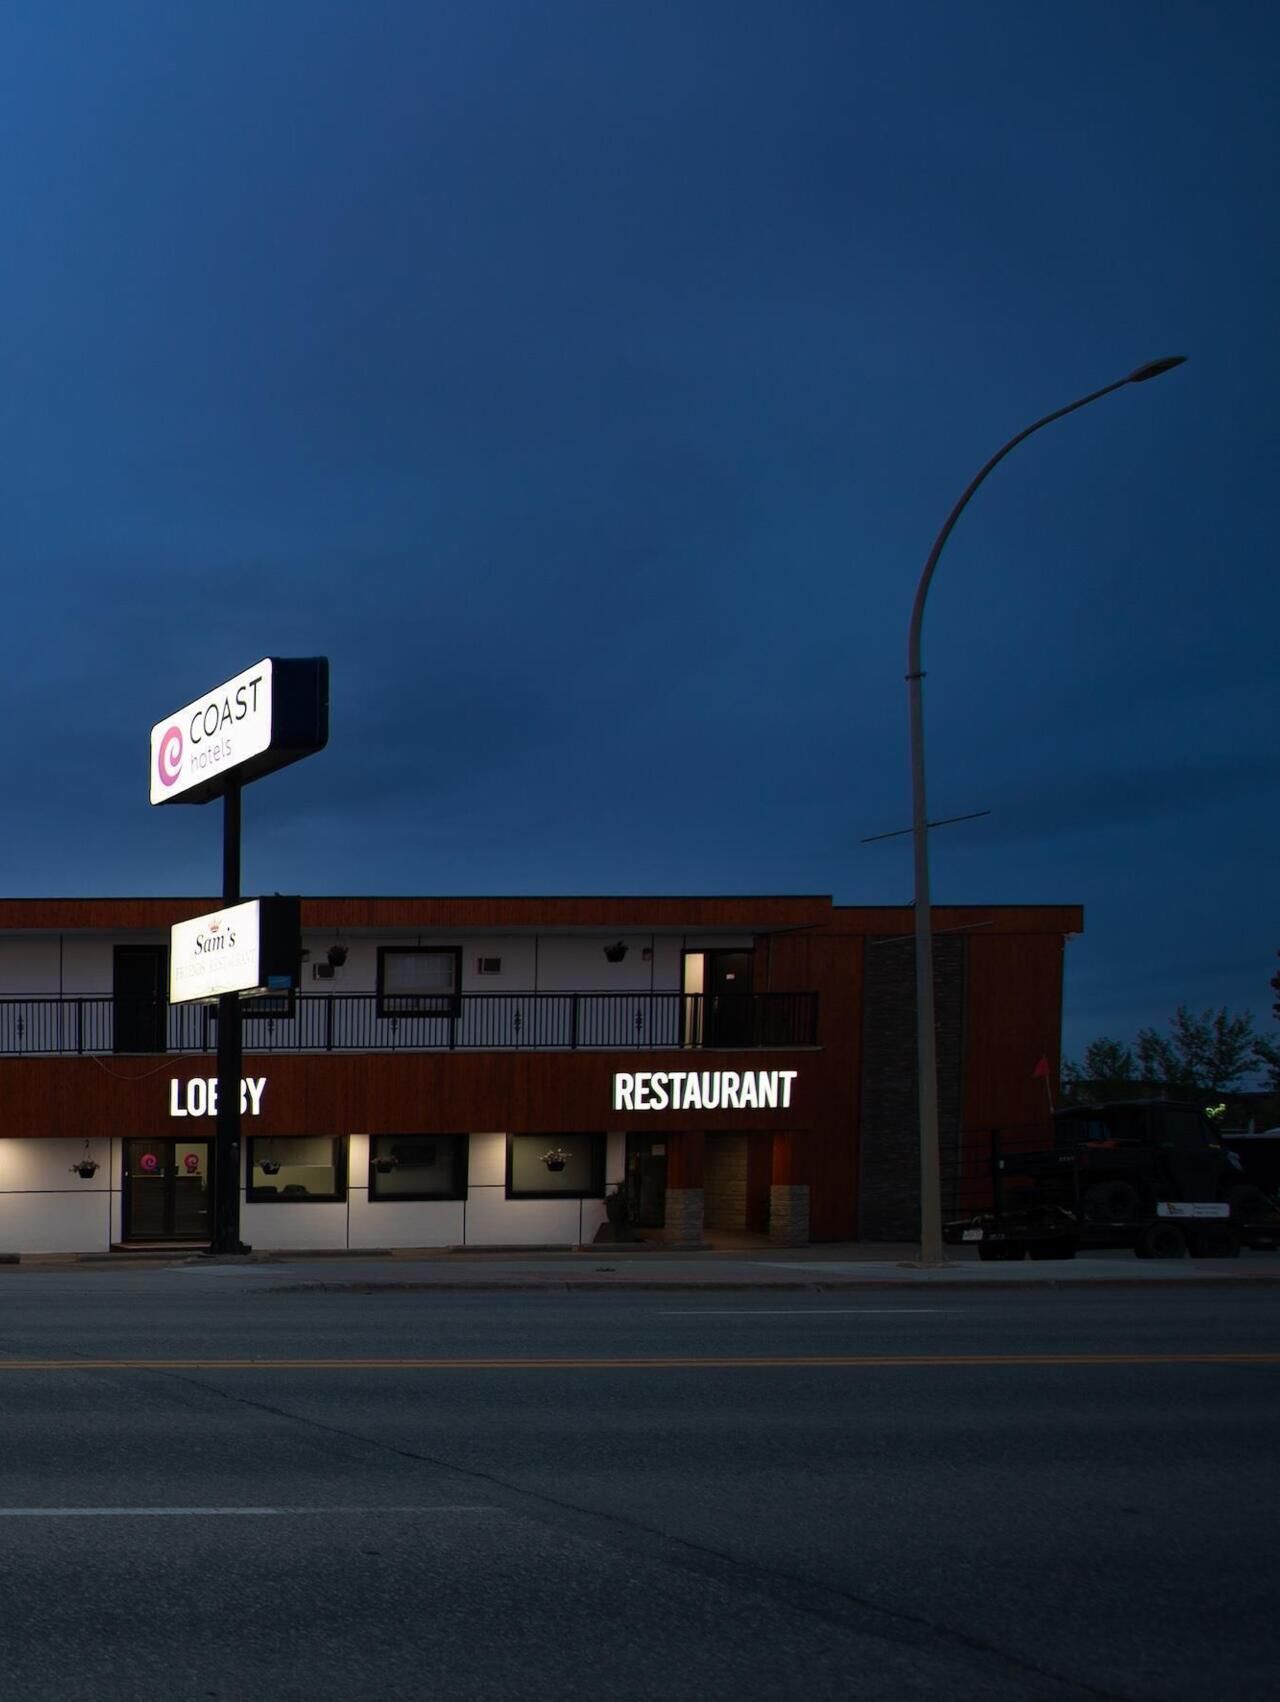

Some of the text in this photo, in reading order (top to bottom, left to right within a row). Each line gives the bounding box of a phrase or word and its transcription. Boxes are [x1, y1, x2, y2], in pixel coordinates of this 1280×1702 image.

[190, 676, 262, 744] COAST
[190, 736, 232, 772] hotels
[194, 926, 237, 955] Sam's
[614, 1071, 798, 1110] RESTAURANT
